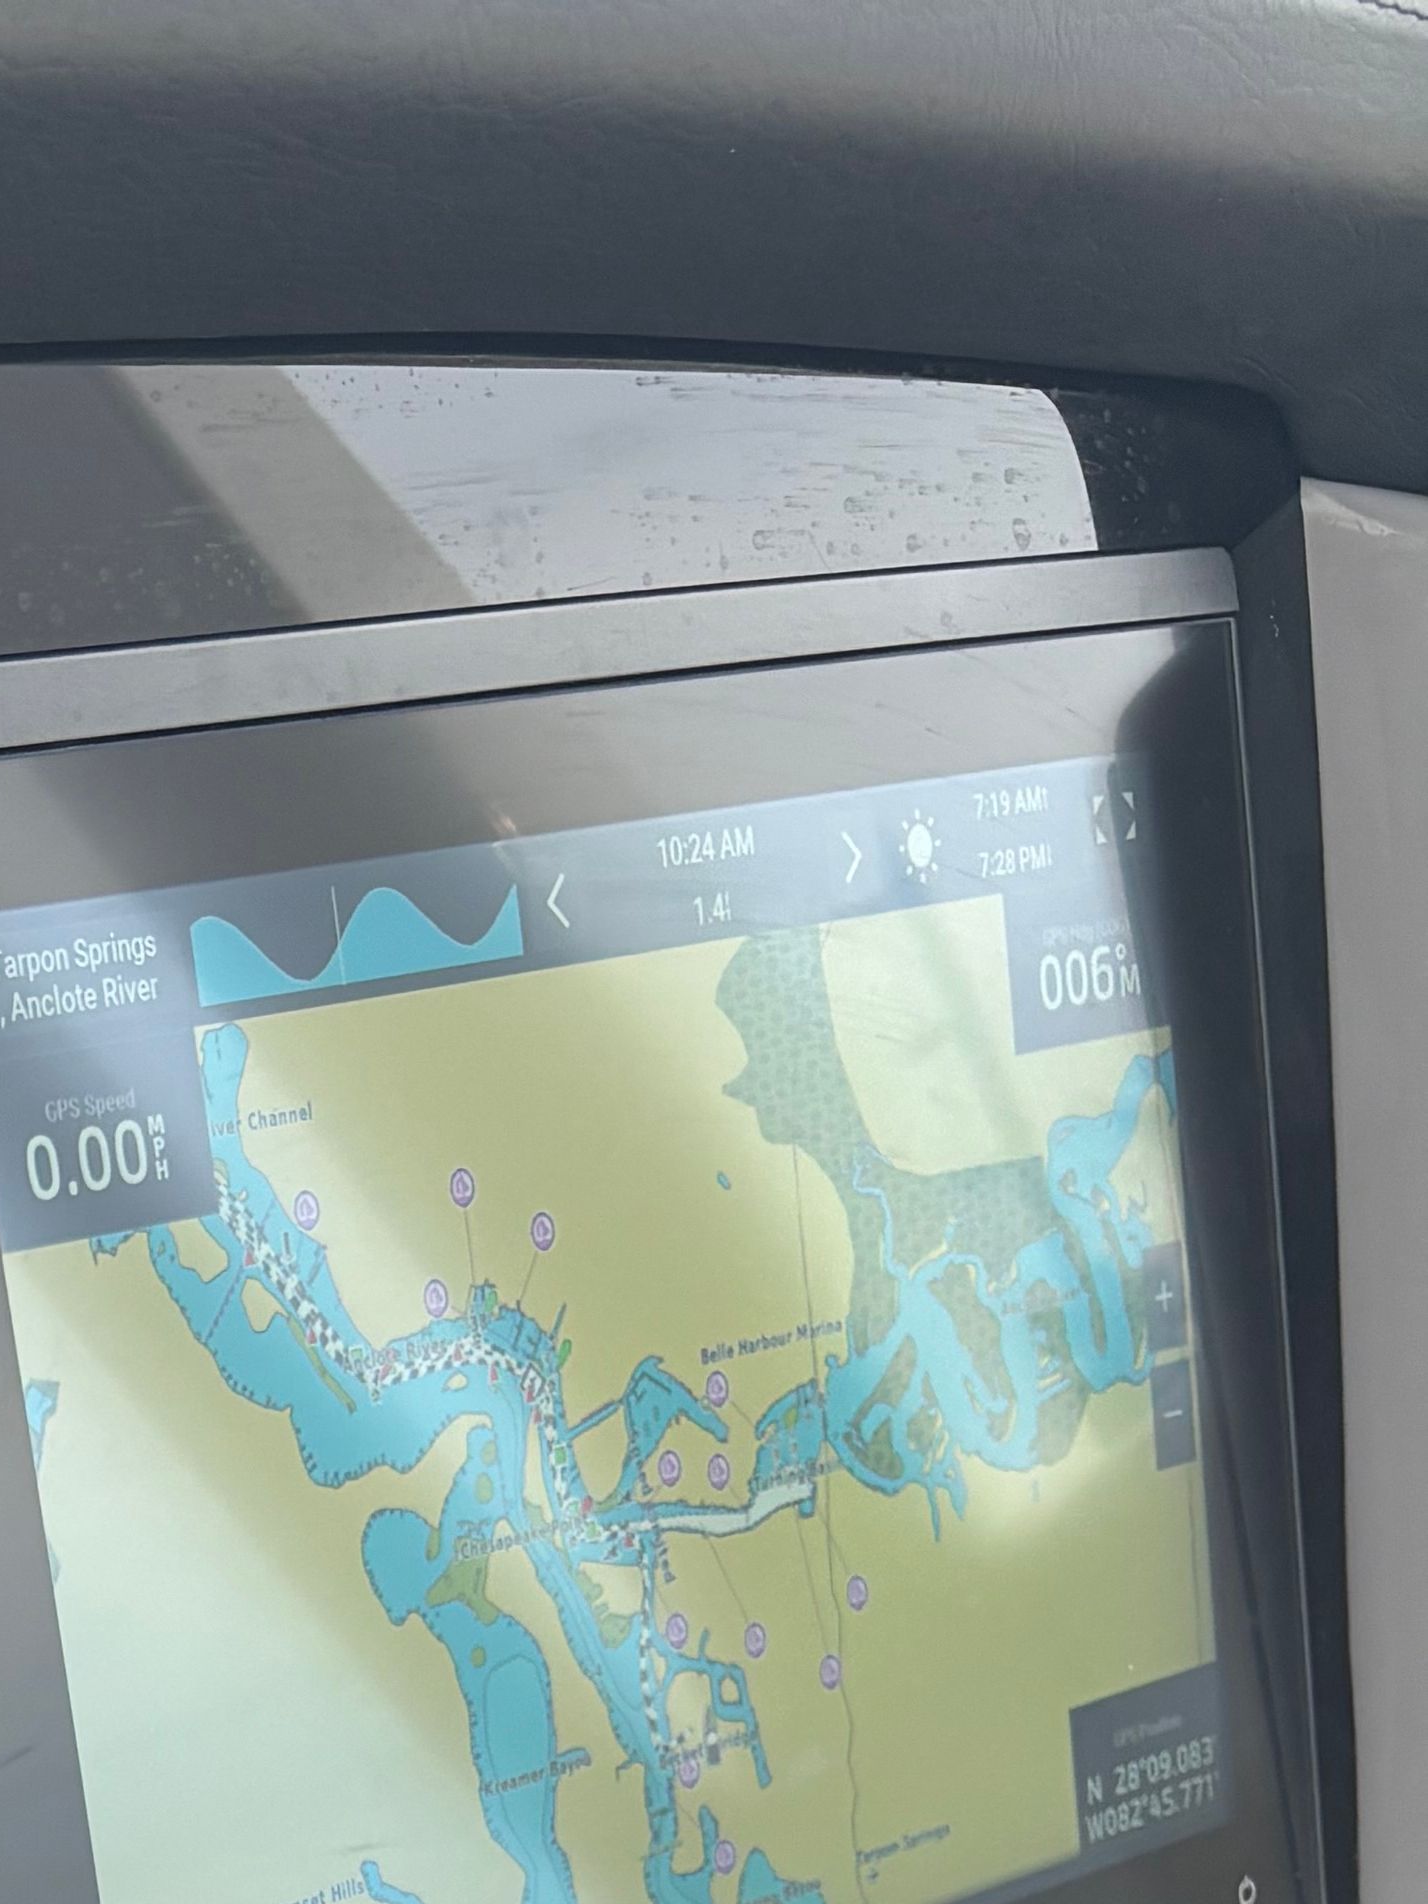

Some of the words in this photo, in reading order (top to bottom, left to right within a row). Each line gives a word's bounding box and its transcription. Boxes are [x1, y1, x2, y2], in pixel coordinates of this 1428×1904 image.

[656, 831, 715, 868] 10:24
[719, 825, 754, 860] AM
[73, 931, 157, 971] Springs
[9, 987, 99, 1024] Anclote
[102, 976, 158, 1009] River
[84, 1087, 136, 1119] Speed
[247, 1101, 314, 1131] Channel
[26, 1119, 147, 1201] 0.00
[700, 1347, 734, 1366] Belle
[737, 1331, 792, 1357] Harbour
[484, 1768, 544, 1797] Kreamer
[331, 1878, 365, 1904] Hills
